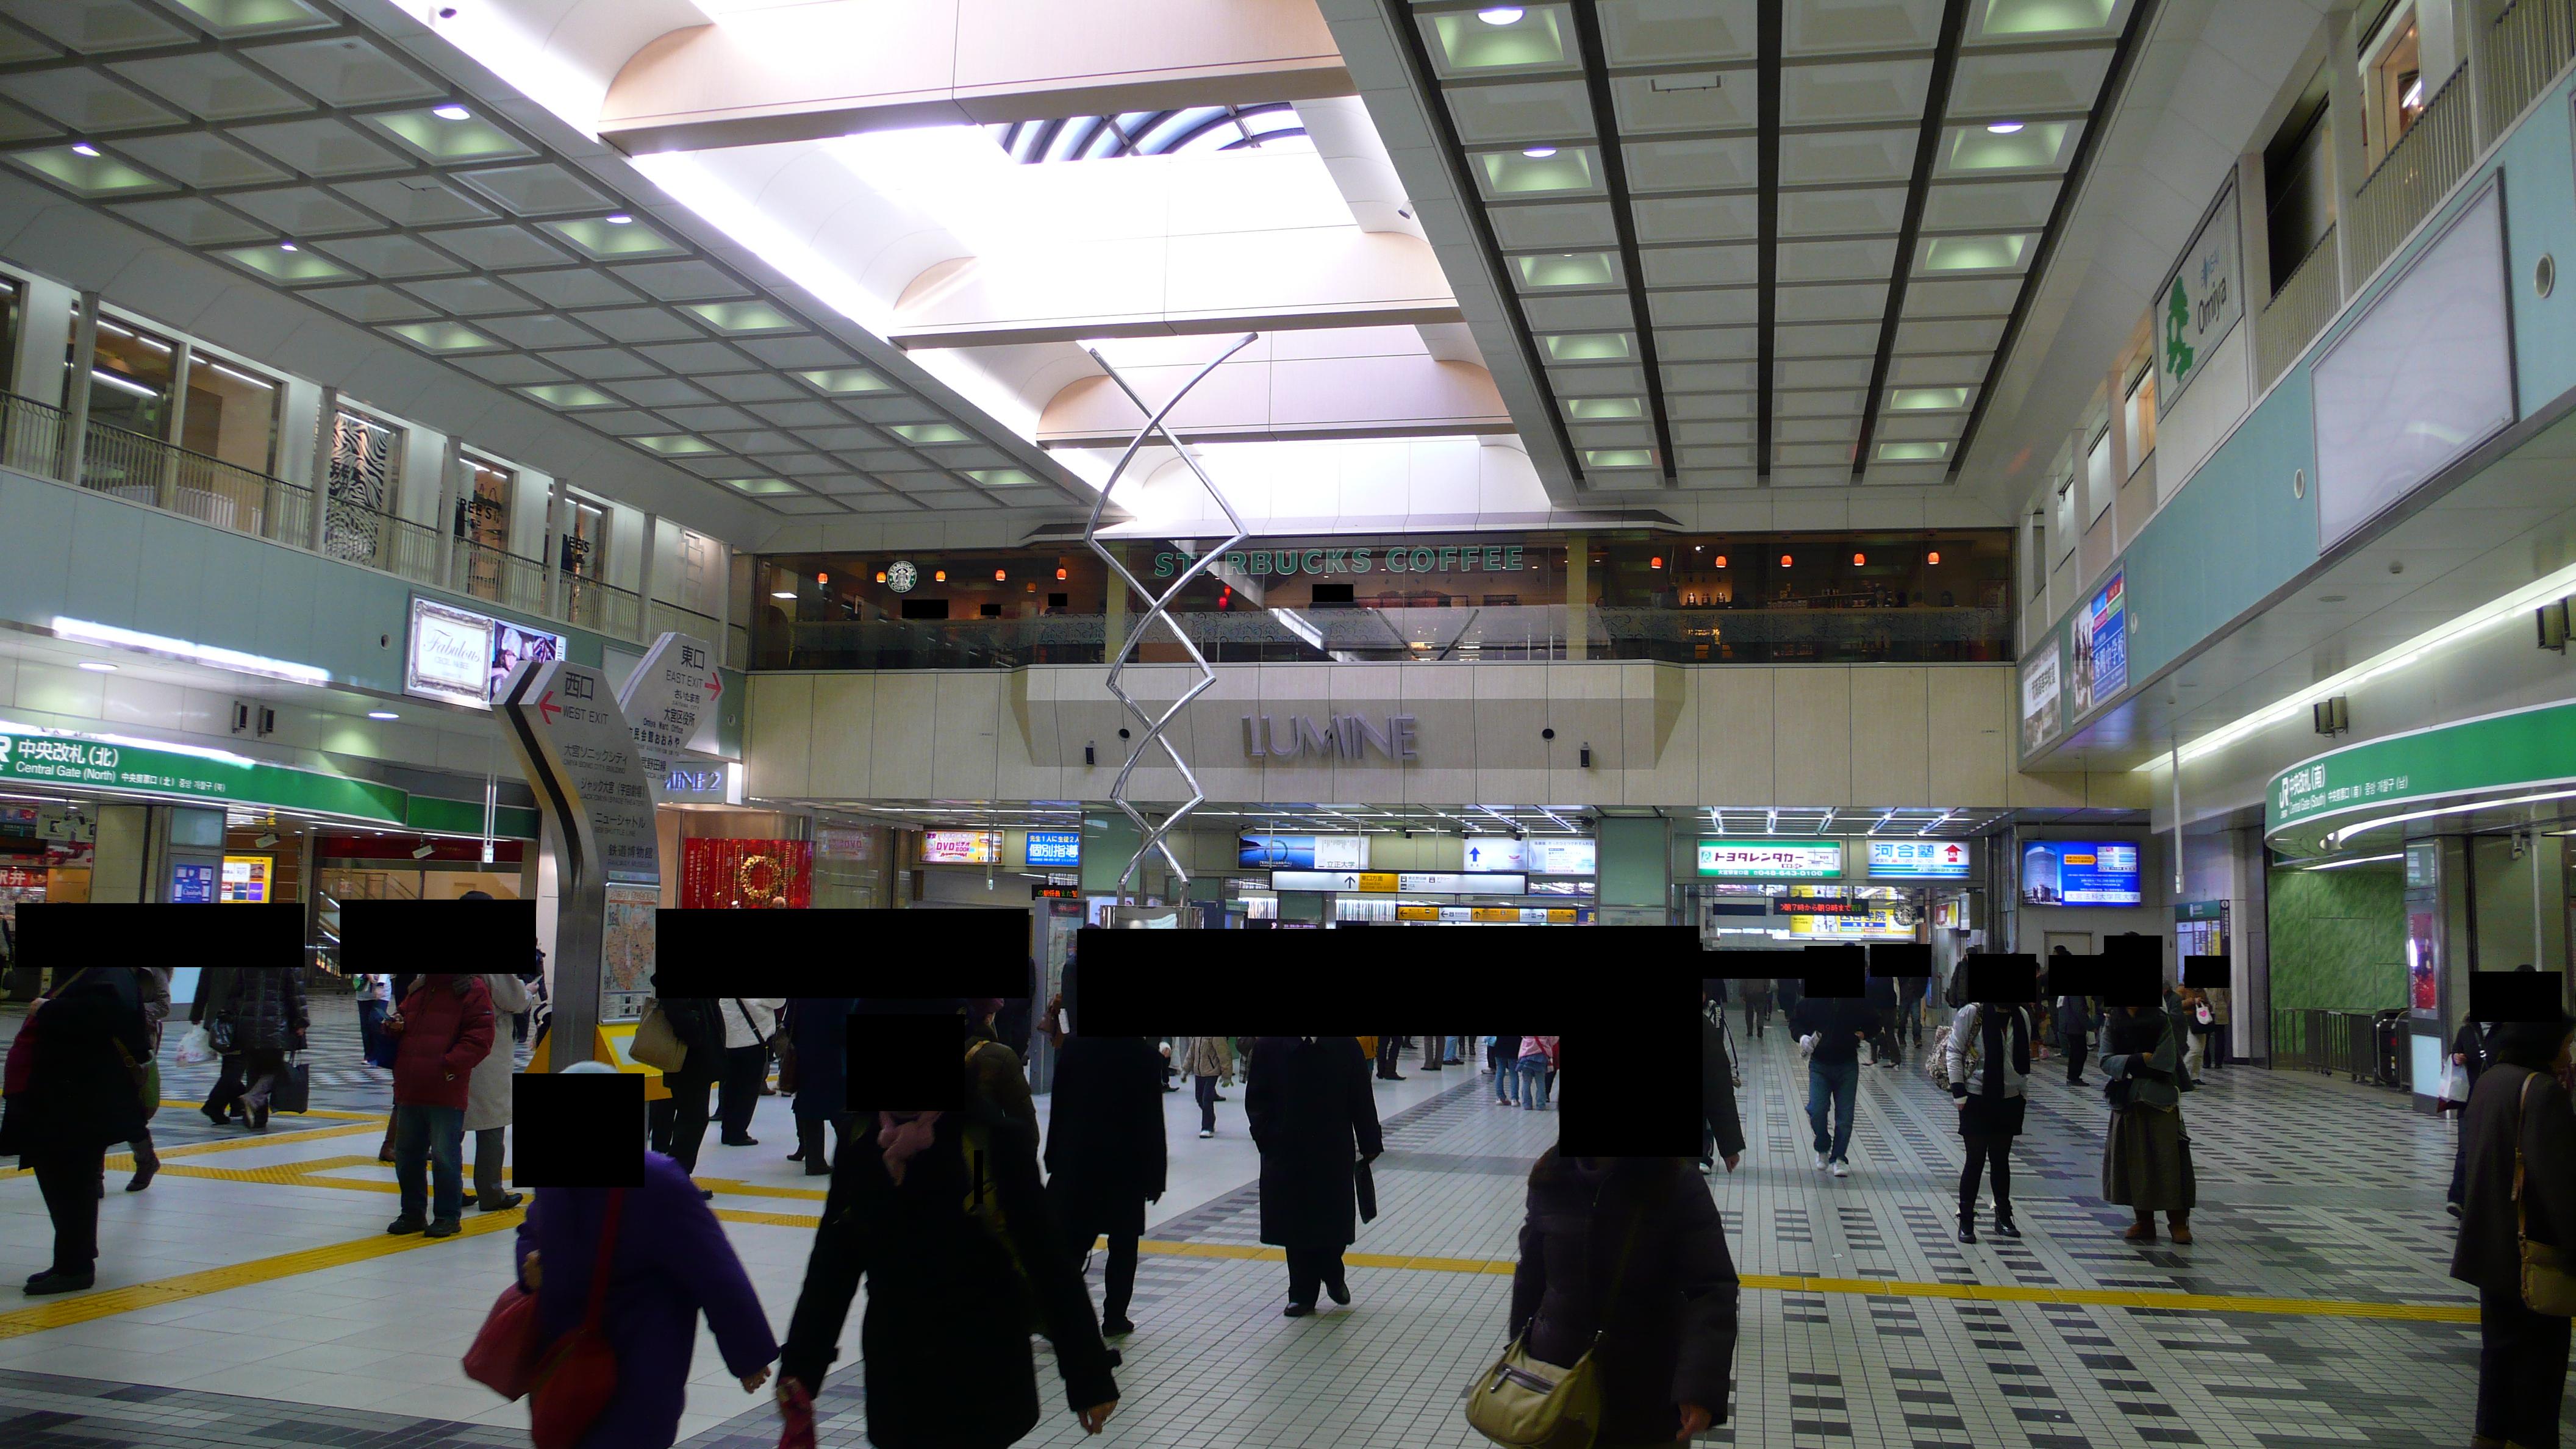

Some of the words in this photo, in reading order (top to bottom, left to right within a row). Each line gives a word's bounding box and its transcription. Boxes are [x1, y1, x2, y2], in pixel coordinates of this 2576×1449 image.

[2198, 277, 2227, 335] Omiya
[1386, 545, 1523, 573] COFFEE
[681, 645, 705, 670] 東口
[565, 671, 594, 701] 西口
[666, 670, 685, 684] EAST
[687, 676, 703, 689] EXIT
[674, 689, 700, 704] さいたま市
[564, 704, 586, 720] WEST
[589, 710, 609, 724] EXIT
[664, 707, 695, 728] 大宮区役所
[1242, 714, 1418, 760] LUMINE
[564, 743, 628, 766] 大宮ソニックシティ
[16, 761, 54, 775] Central
[56, 765, 82, 778] Gate
[83, 767, 116, 783] (North)
[709, 771, 722, 792] 2
[2279, 776, 2289, 809] JR
[595, 812, 645, 828] ニューシャトル
[608, 844, 653, 859] 鉄道博物館
[936, 842, 955, 851] DVD
[1029, 844, 1079, 858] 個別指導
[1875, 844, 1934, 858] 河合塾
[1715, 853, 1804, 862] トヨタレンタカー
